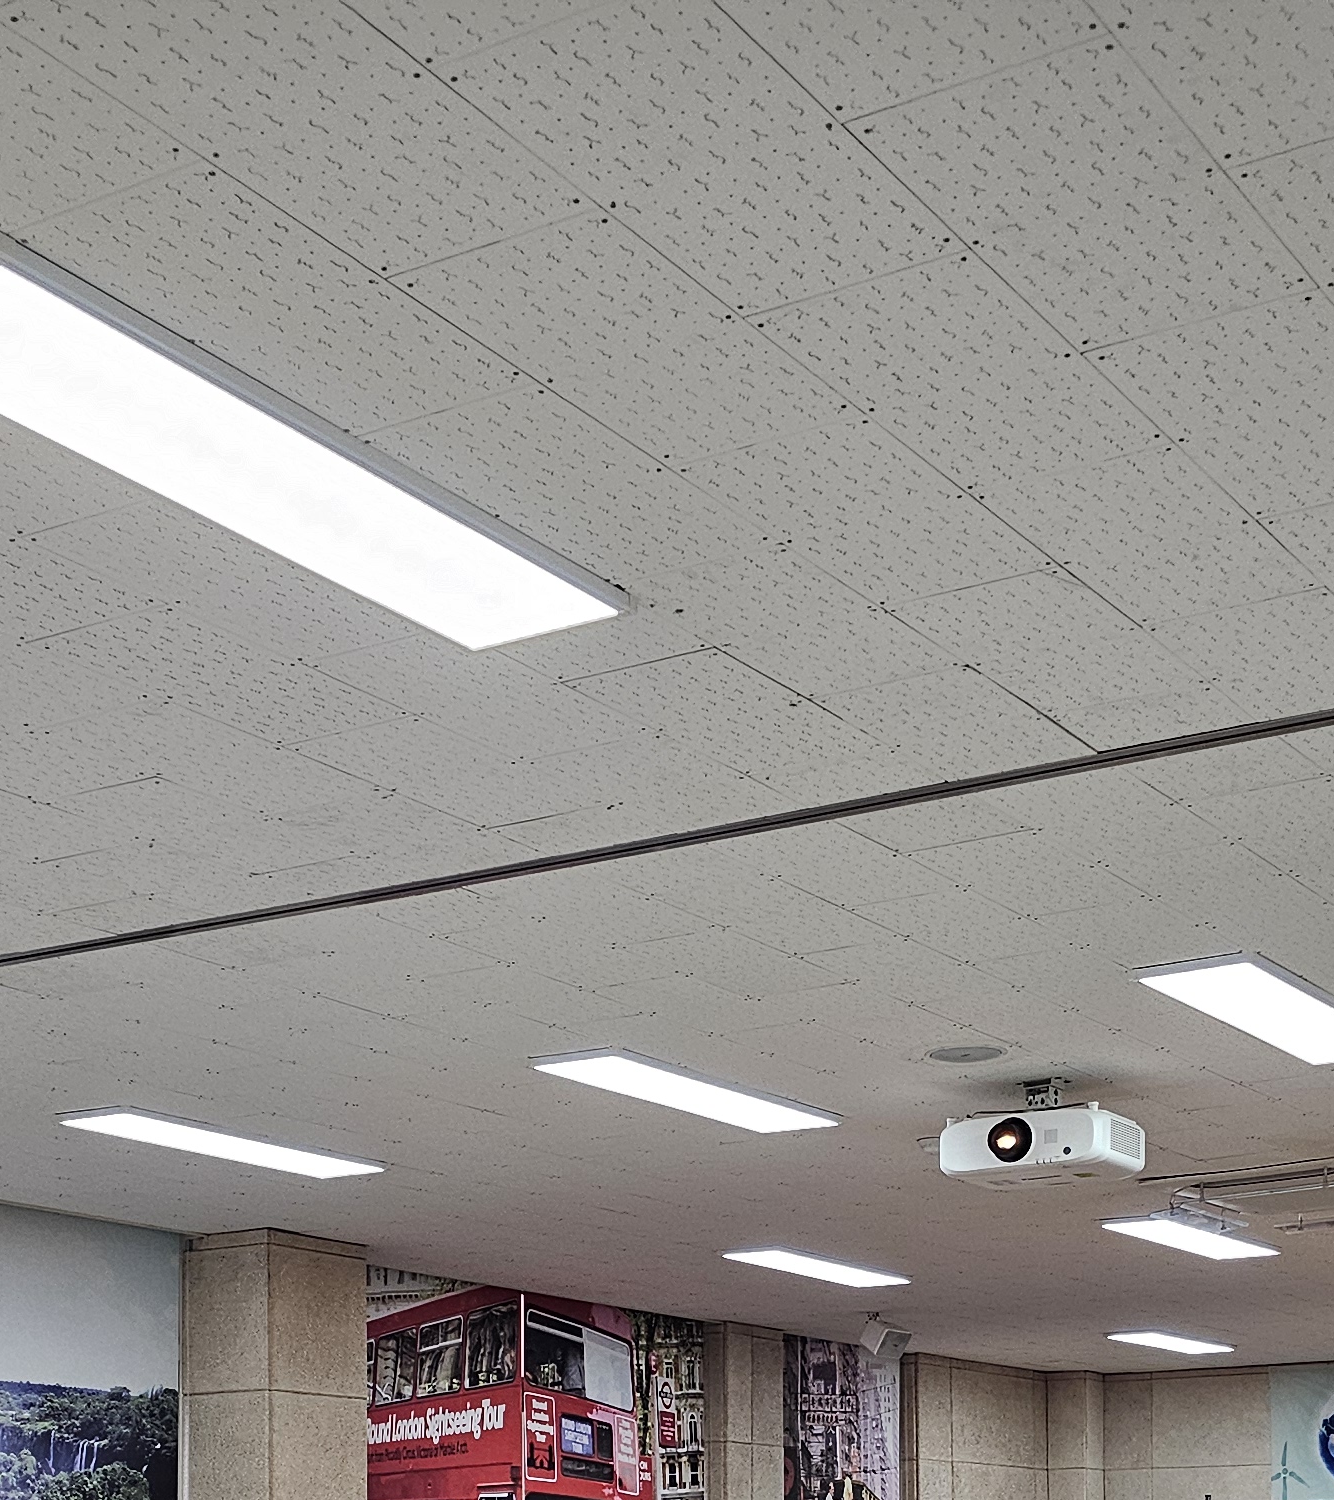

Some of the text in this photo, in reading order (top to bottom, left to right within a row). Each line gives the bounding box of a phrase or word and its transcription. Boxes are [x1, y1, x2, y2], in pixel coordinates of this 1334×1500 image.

[392, 1410, 425, 1442] London
[426, 1401, 482, 1444] Sightseeing
[482, 1399, 506, 1430] Tour
